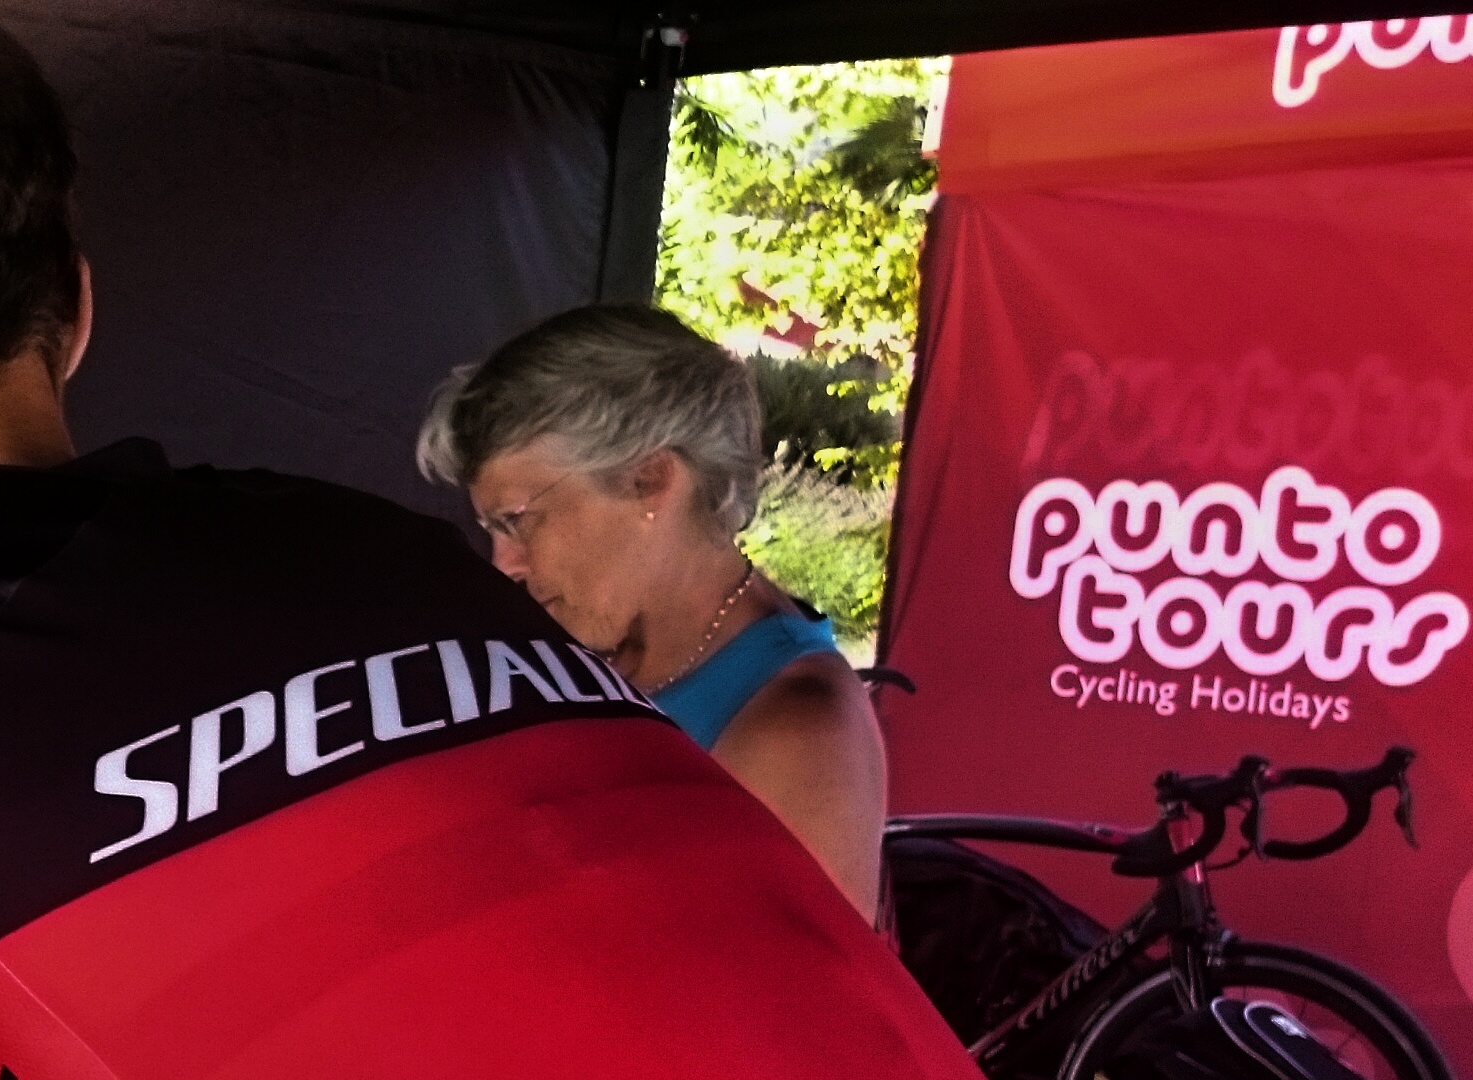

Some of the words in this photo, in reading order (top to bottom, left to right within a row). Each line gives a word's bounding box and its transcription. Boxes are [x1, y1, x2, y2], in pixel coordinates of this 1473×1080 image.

[1009, 466, 1441, 598] punto
[1058, 555, 1470, 687] tours
[1051, 664, 1177, 715] Cycling
[1191, 675, 1352, 730] Holidays
